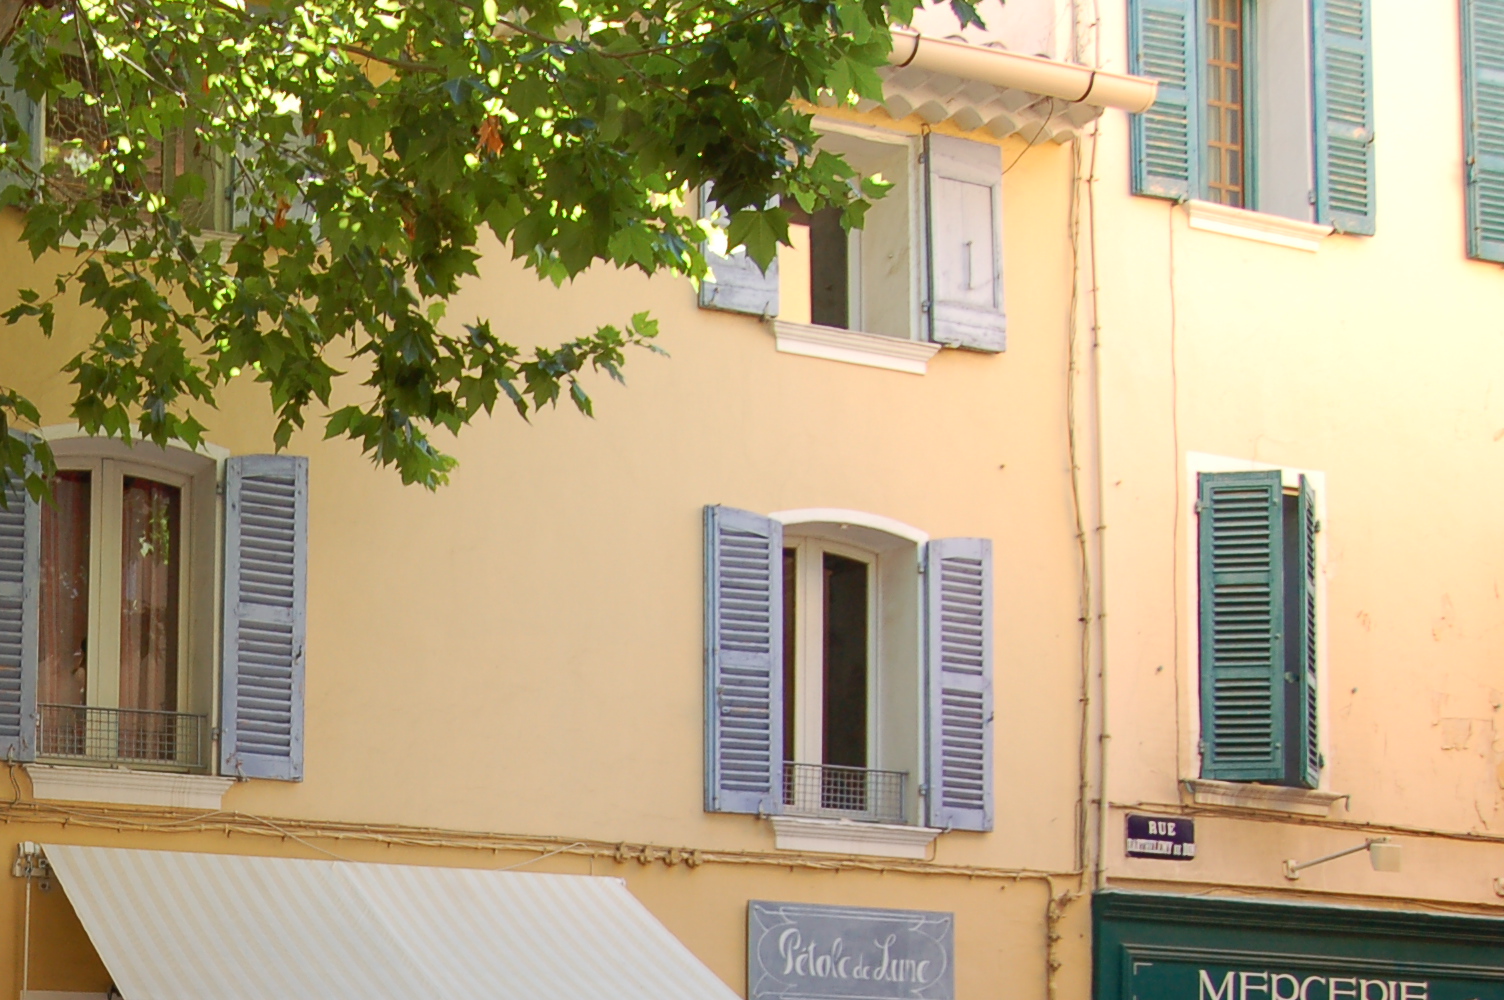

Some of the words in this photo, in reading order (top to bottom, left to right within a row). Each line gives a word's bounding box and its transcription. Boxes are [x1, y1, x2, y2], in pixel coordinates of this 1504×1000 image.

[1148, 820, 1177, 836] RUE
[853, 952, 871, 980] de
[873, 933, 931, 984] Lune
